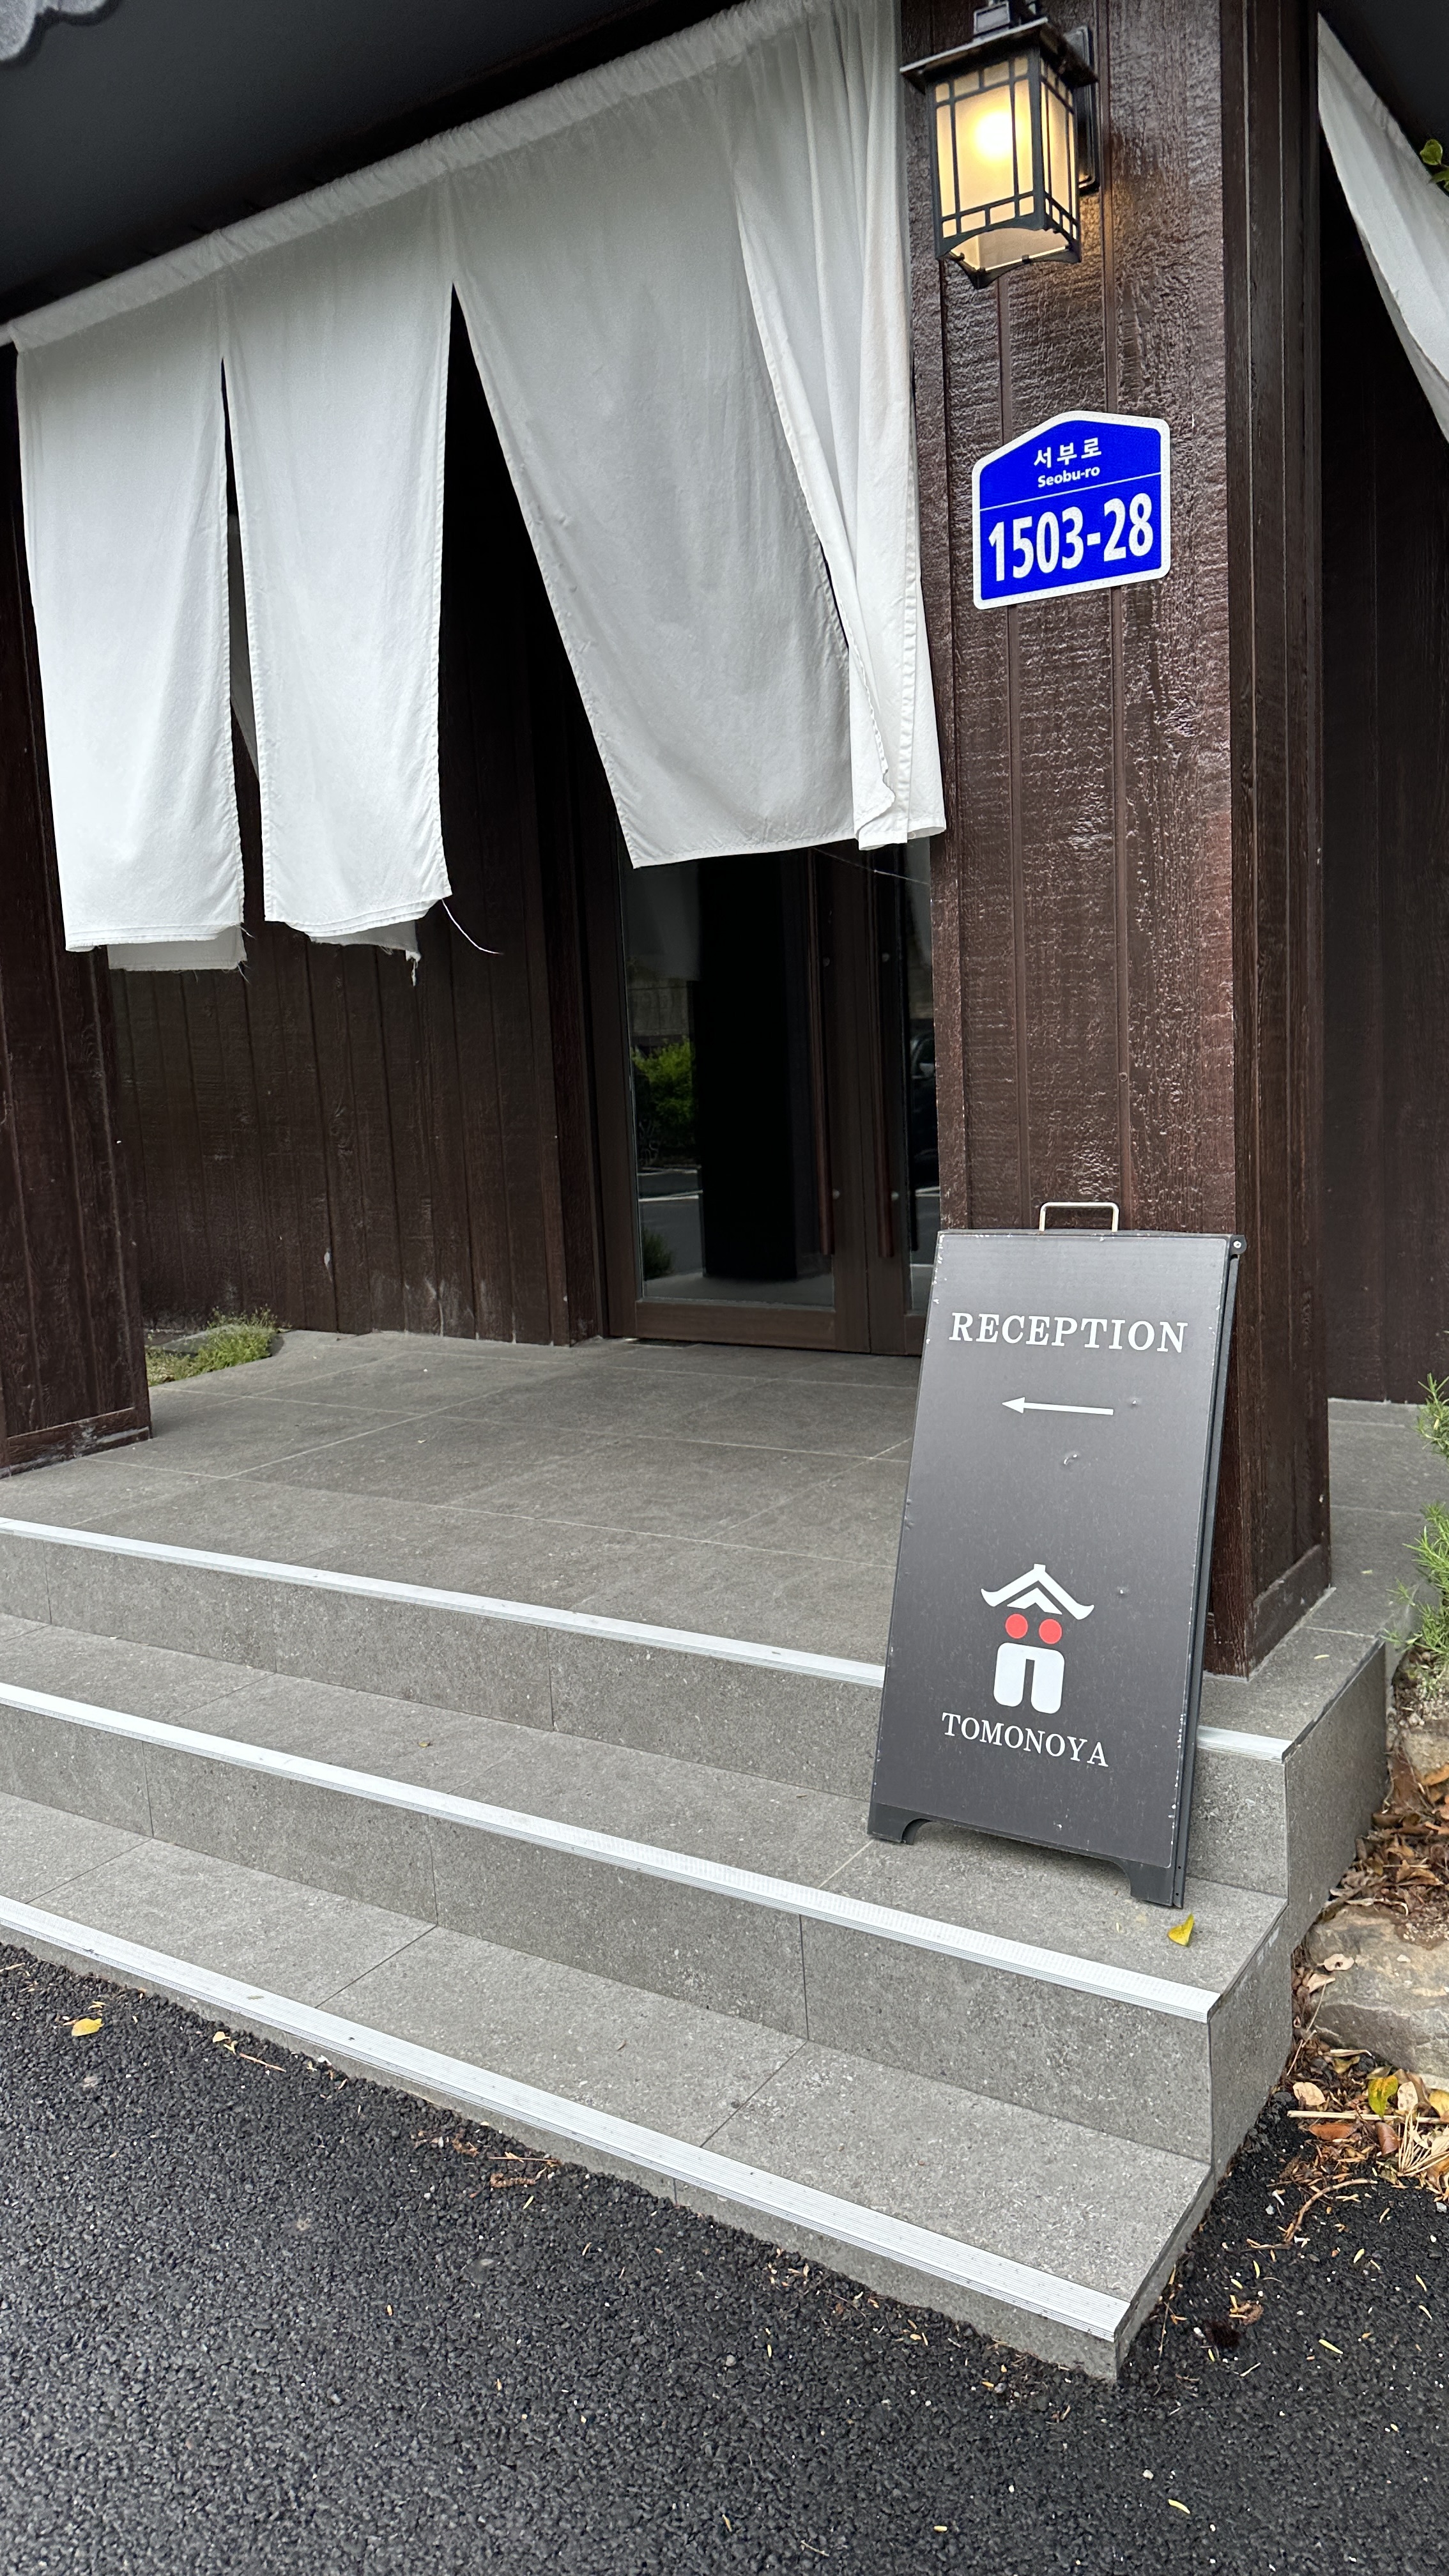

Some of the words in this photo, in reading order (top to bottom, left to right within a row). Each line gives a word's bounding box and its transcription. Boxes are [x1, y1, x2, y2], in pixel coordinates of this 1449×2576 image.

[1037, 465, 1101, 488] Seobu-ro
[988, 492, 1154, 582] 1503-28
[948, 1312, 1188, 1354] RECEPTION
[941, 1712, 1109, 1768] TOMONOYA
